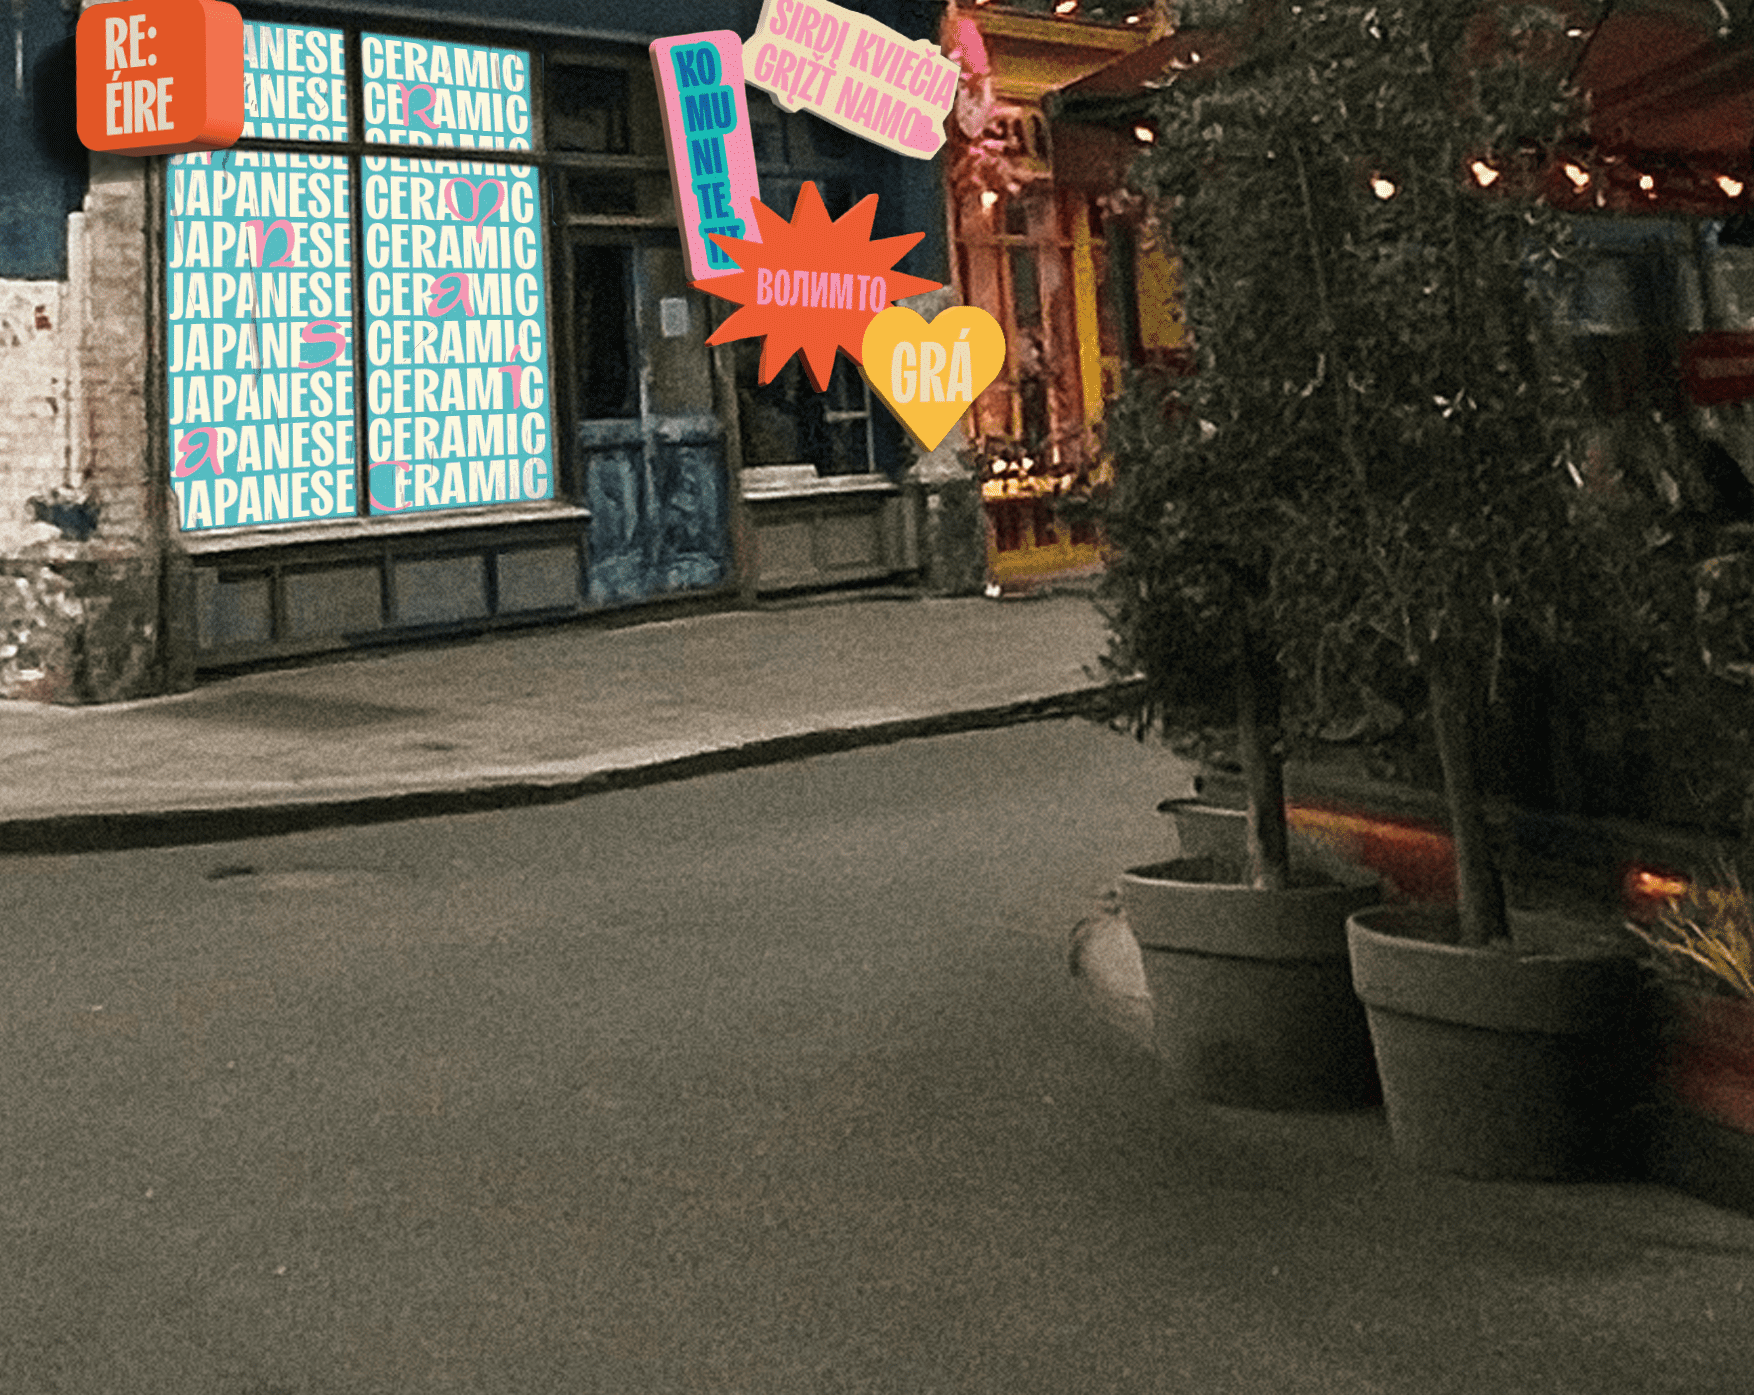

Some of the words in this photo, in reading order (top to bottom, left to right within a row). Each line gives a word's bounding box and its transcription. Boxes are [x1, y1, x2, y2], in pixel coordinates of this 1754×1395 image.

[105, 14, 157, 70] RE:
[361, 36, 525, 92] CERAMIC
[106, 70, 175, 136] ÉIRE
[170, 169, 349, 219] JAPANESE
[366, 222, 537, 270] CERAMIC
[169, 271, 352, 321] JAPANESE
[368, 318, 542, 366] CERAMIC
[169, 370, 354, 425] JAPANESE
[368, 411, 546, 463] CERAMIC
